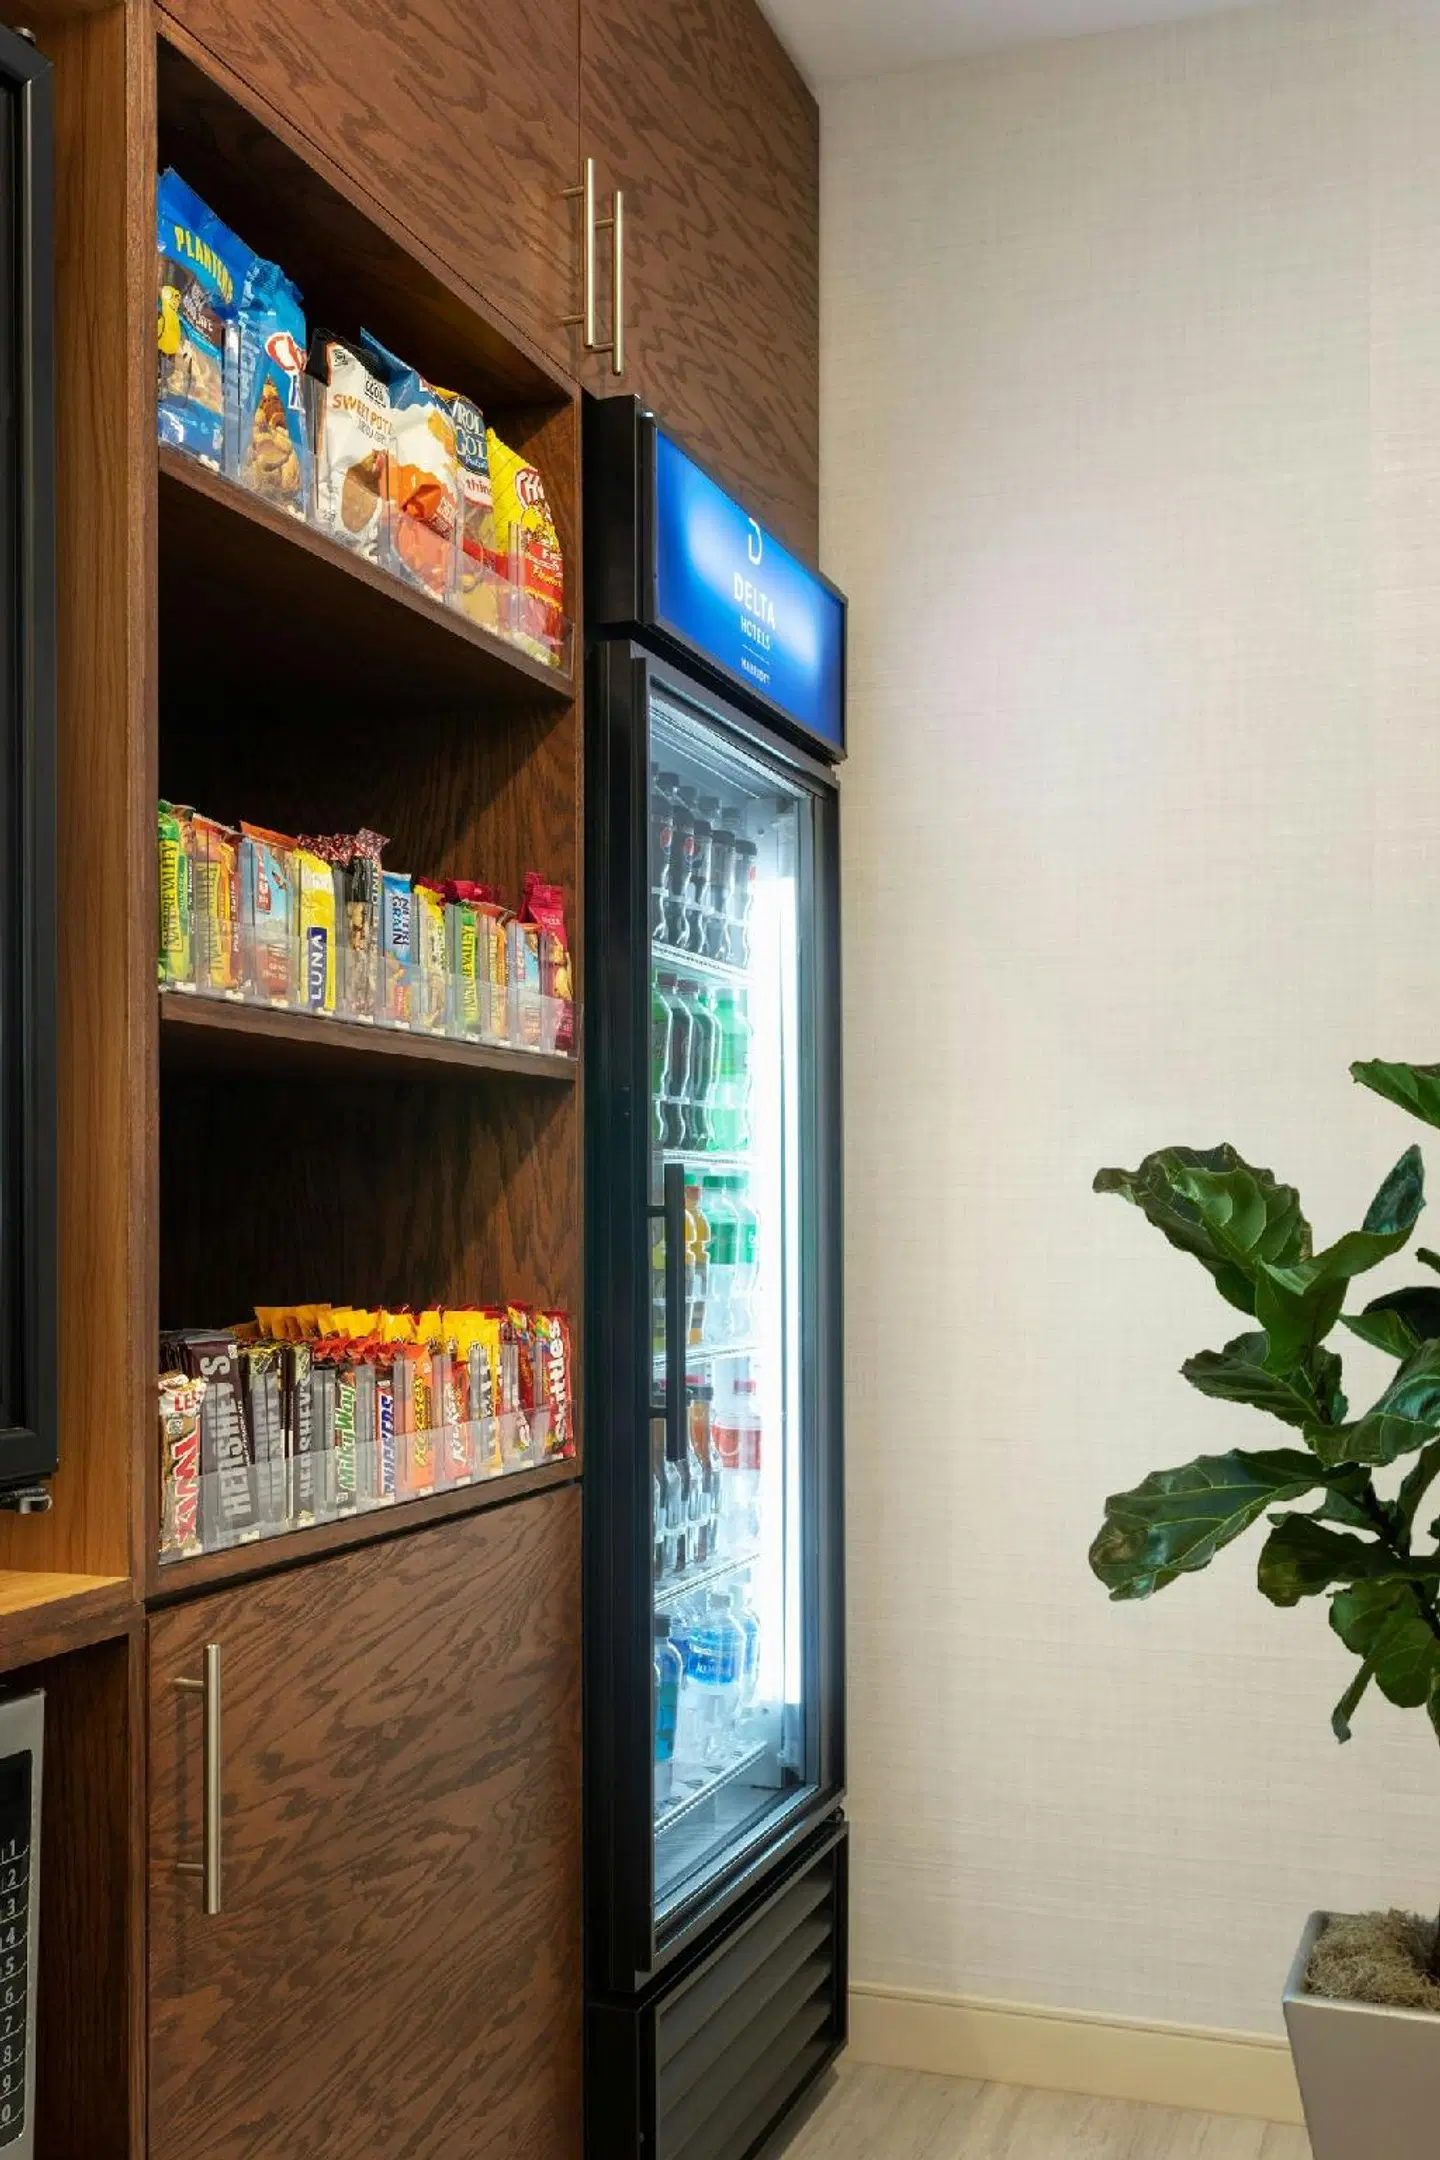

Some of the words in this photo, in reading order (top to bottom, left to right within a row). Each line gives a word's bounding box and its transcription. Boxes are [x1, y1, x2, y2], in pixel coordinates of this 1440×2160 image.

[174, 225, 234, 305] PLANTERS
[332, 392, 370, 420] SWEET
[733, 571, 776, 631] DELTA
[740, 615, 771, 651] HOTELS
[162, 843, 177, 889] VALLEY
[392, 895, 402, 945] GRAIN
[311, 934, 323, 1000] LUNA
[9, 1839, 16, 1856] 1
[7, 1868, 16, 1887] 2
[7, 1898, 15, 1917] 3
[6, 1927, 15, 1944] 4
[6, 1956, 15, 1975] 5
[6, 1986, 13, 2004] 6
[5, 2015, 13, 2033] 7
[4, 2045, 12, 2063] 8
[3, 2075, 11, 2093] 9
[2, 2104, 11, 2121] 0
